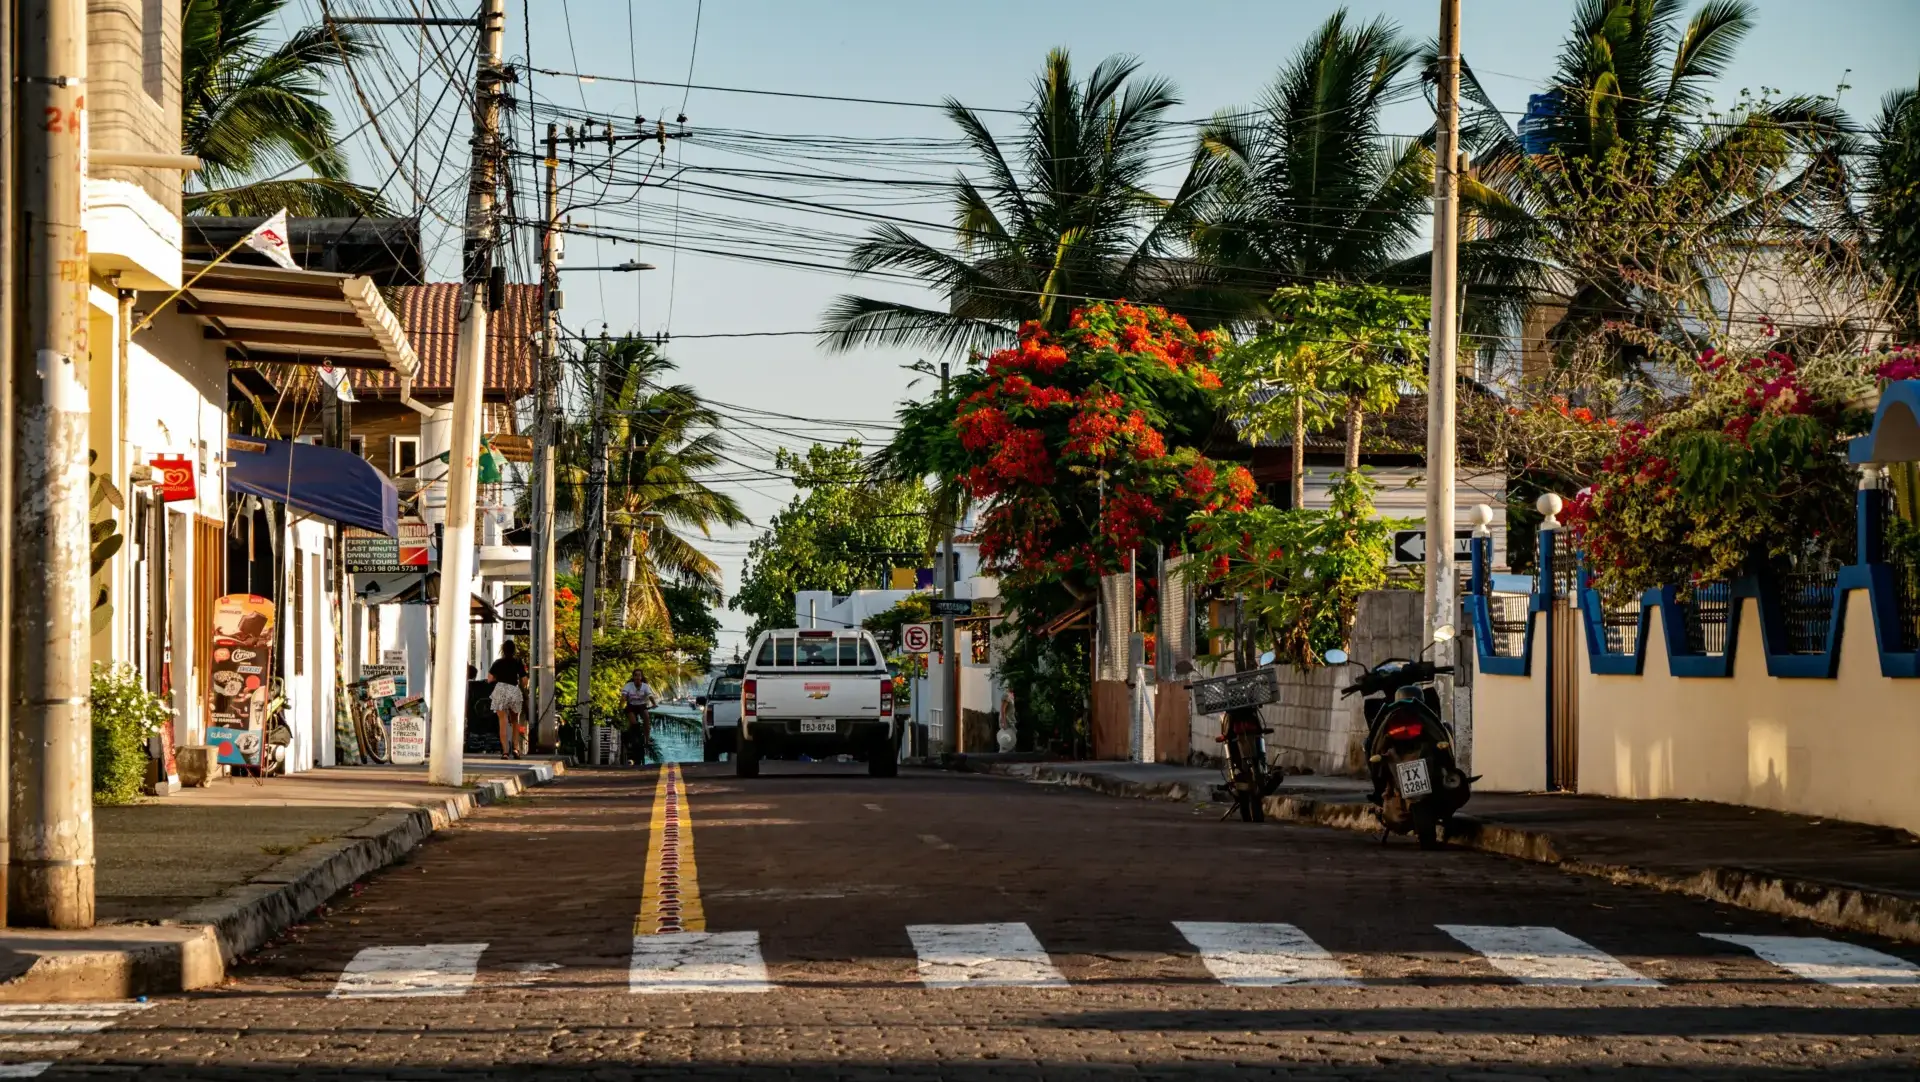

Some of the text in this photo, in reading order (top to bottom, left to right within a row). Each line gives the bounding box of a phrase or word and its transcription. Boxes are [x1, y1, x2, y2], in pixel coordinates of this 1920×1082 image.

[505, 608, 530, 617] BOD
[505, 621, 530, 630] BLA
[1405, 768, 1421, 781] IX
[1404, 779, 1428, 793] 328H
